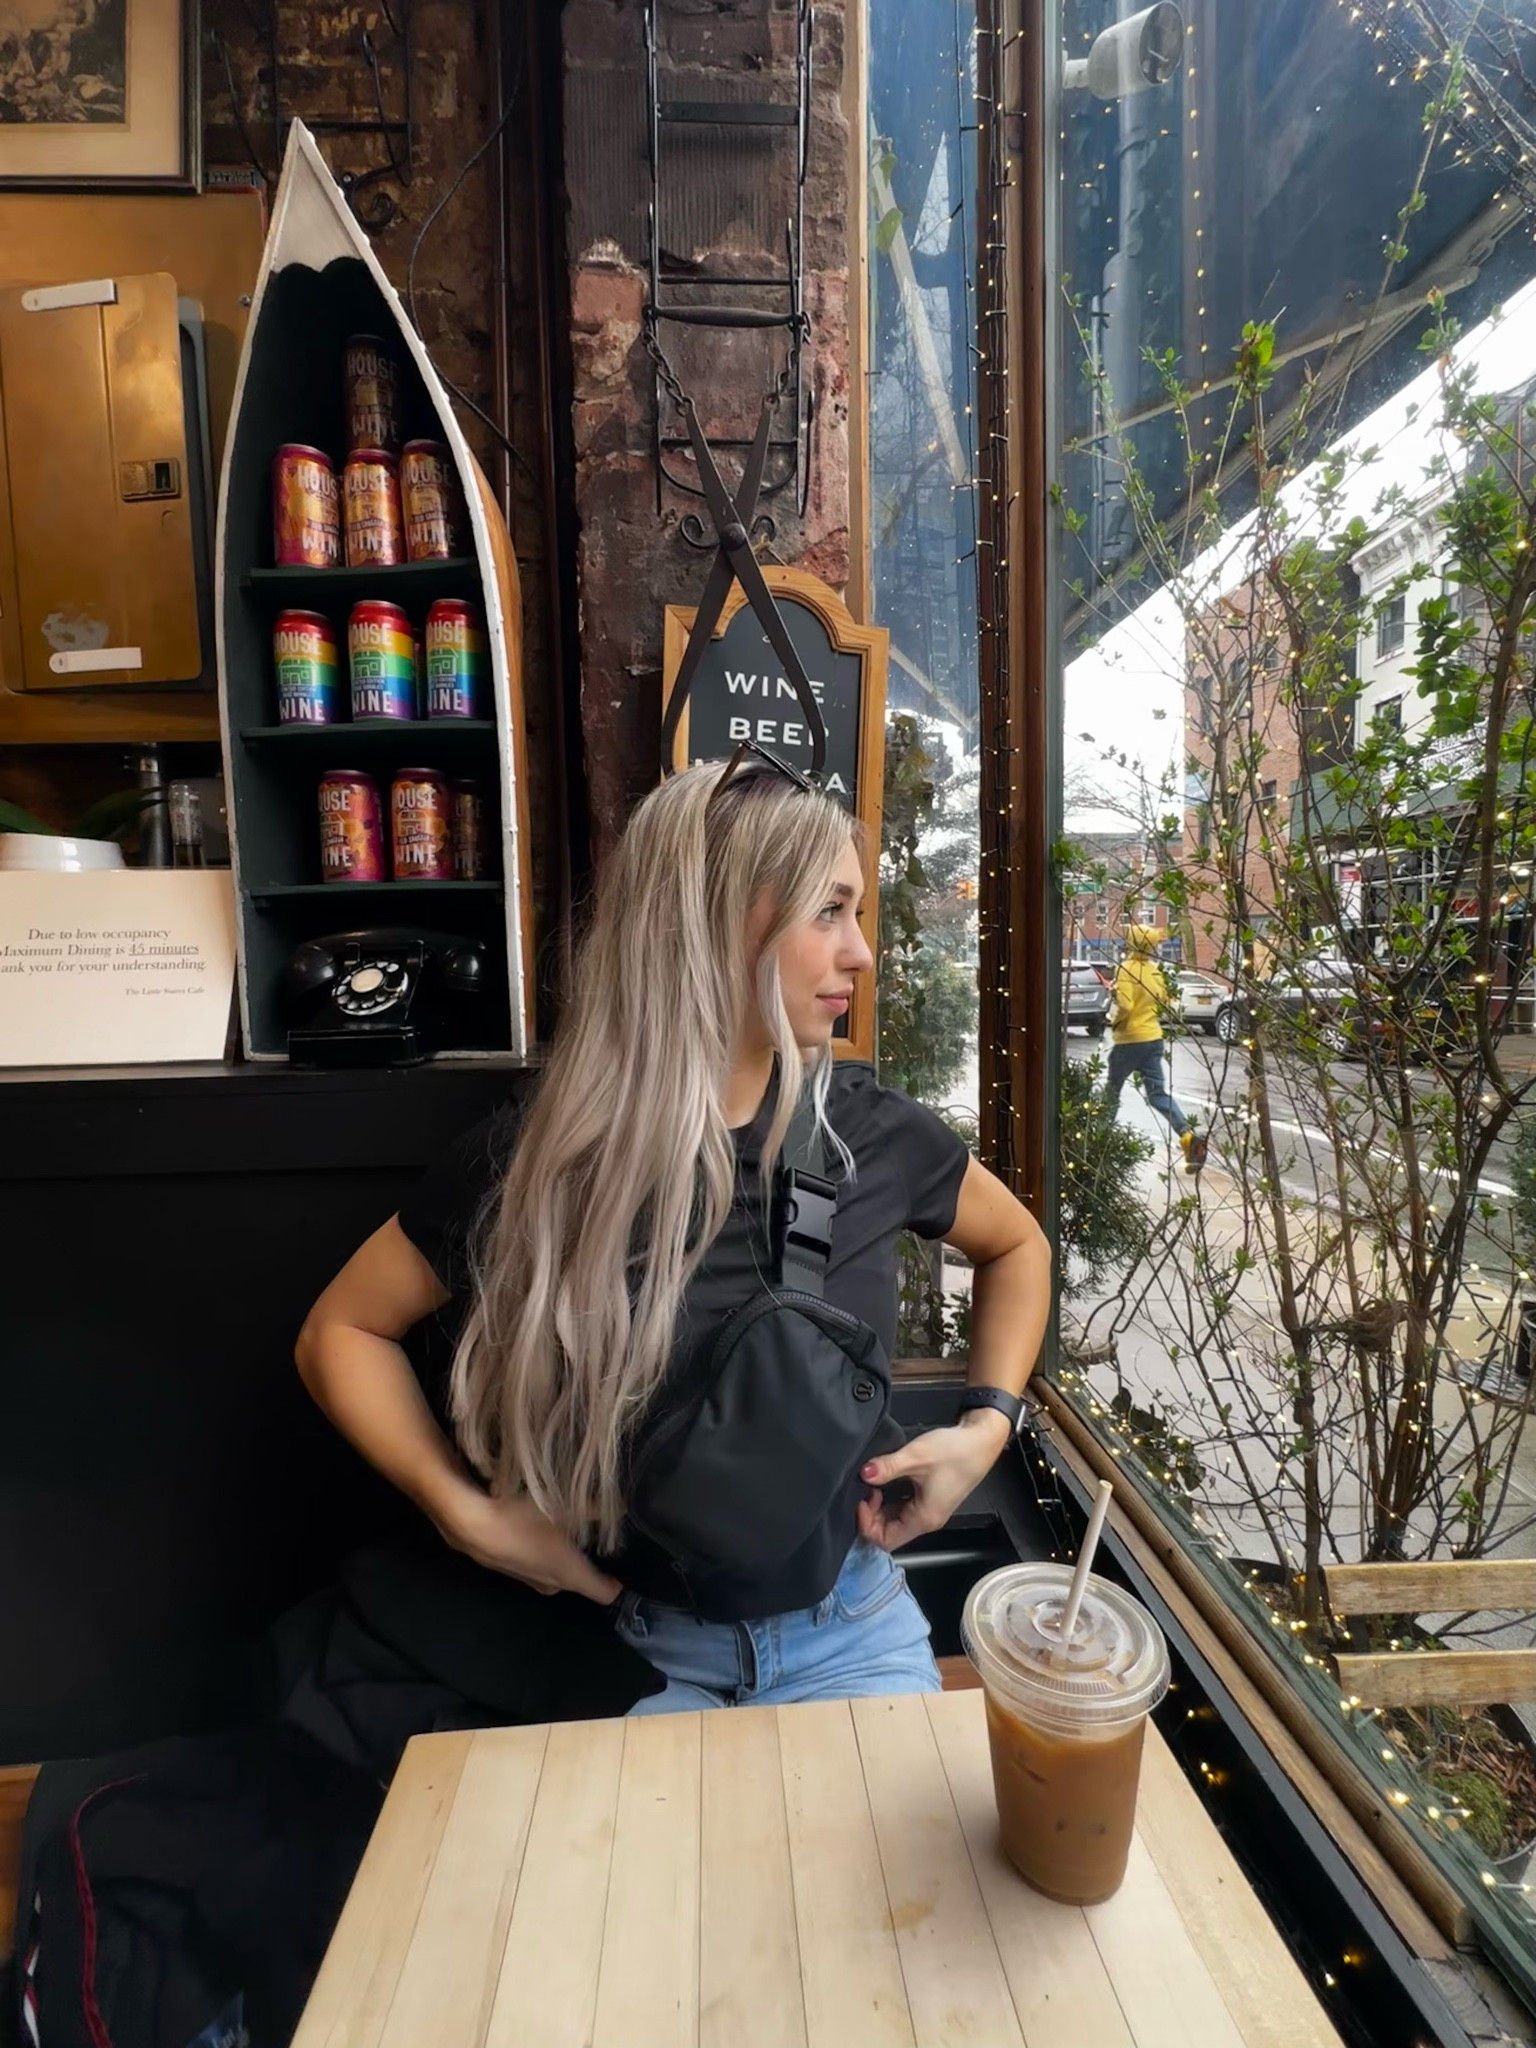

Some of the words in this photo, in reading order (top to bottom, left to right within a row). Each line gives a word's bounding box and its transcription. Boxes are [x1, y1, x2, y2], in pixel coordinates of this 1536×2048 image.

[297, 463, 339, 501] HOUS
[301, 528, 339, 559] WIN
[322, 846, 353, 868] INE
[28, 928, 56, 940] Due
[59, 931, 73, 940] to
[76, 928, 97, 940] low
[101, 929, 171, 942] occupancy
[67, 944, 112, 958] Dining
[115, 943, 126, 955] is
[149, 942, 200, 956] minutes
[0, 961, 25, 974] ank
[28, 964, 53, 977] you
[56, 960, 76, 973] for
[78, 963, 110, 976] your
